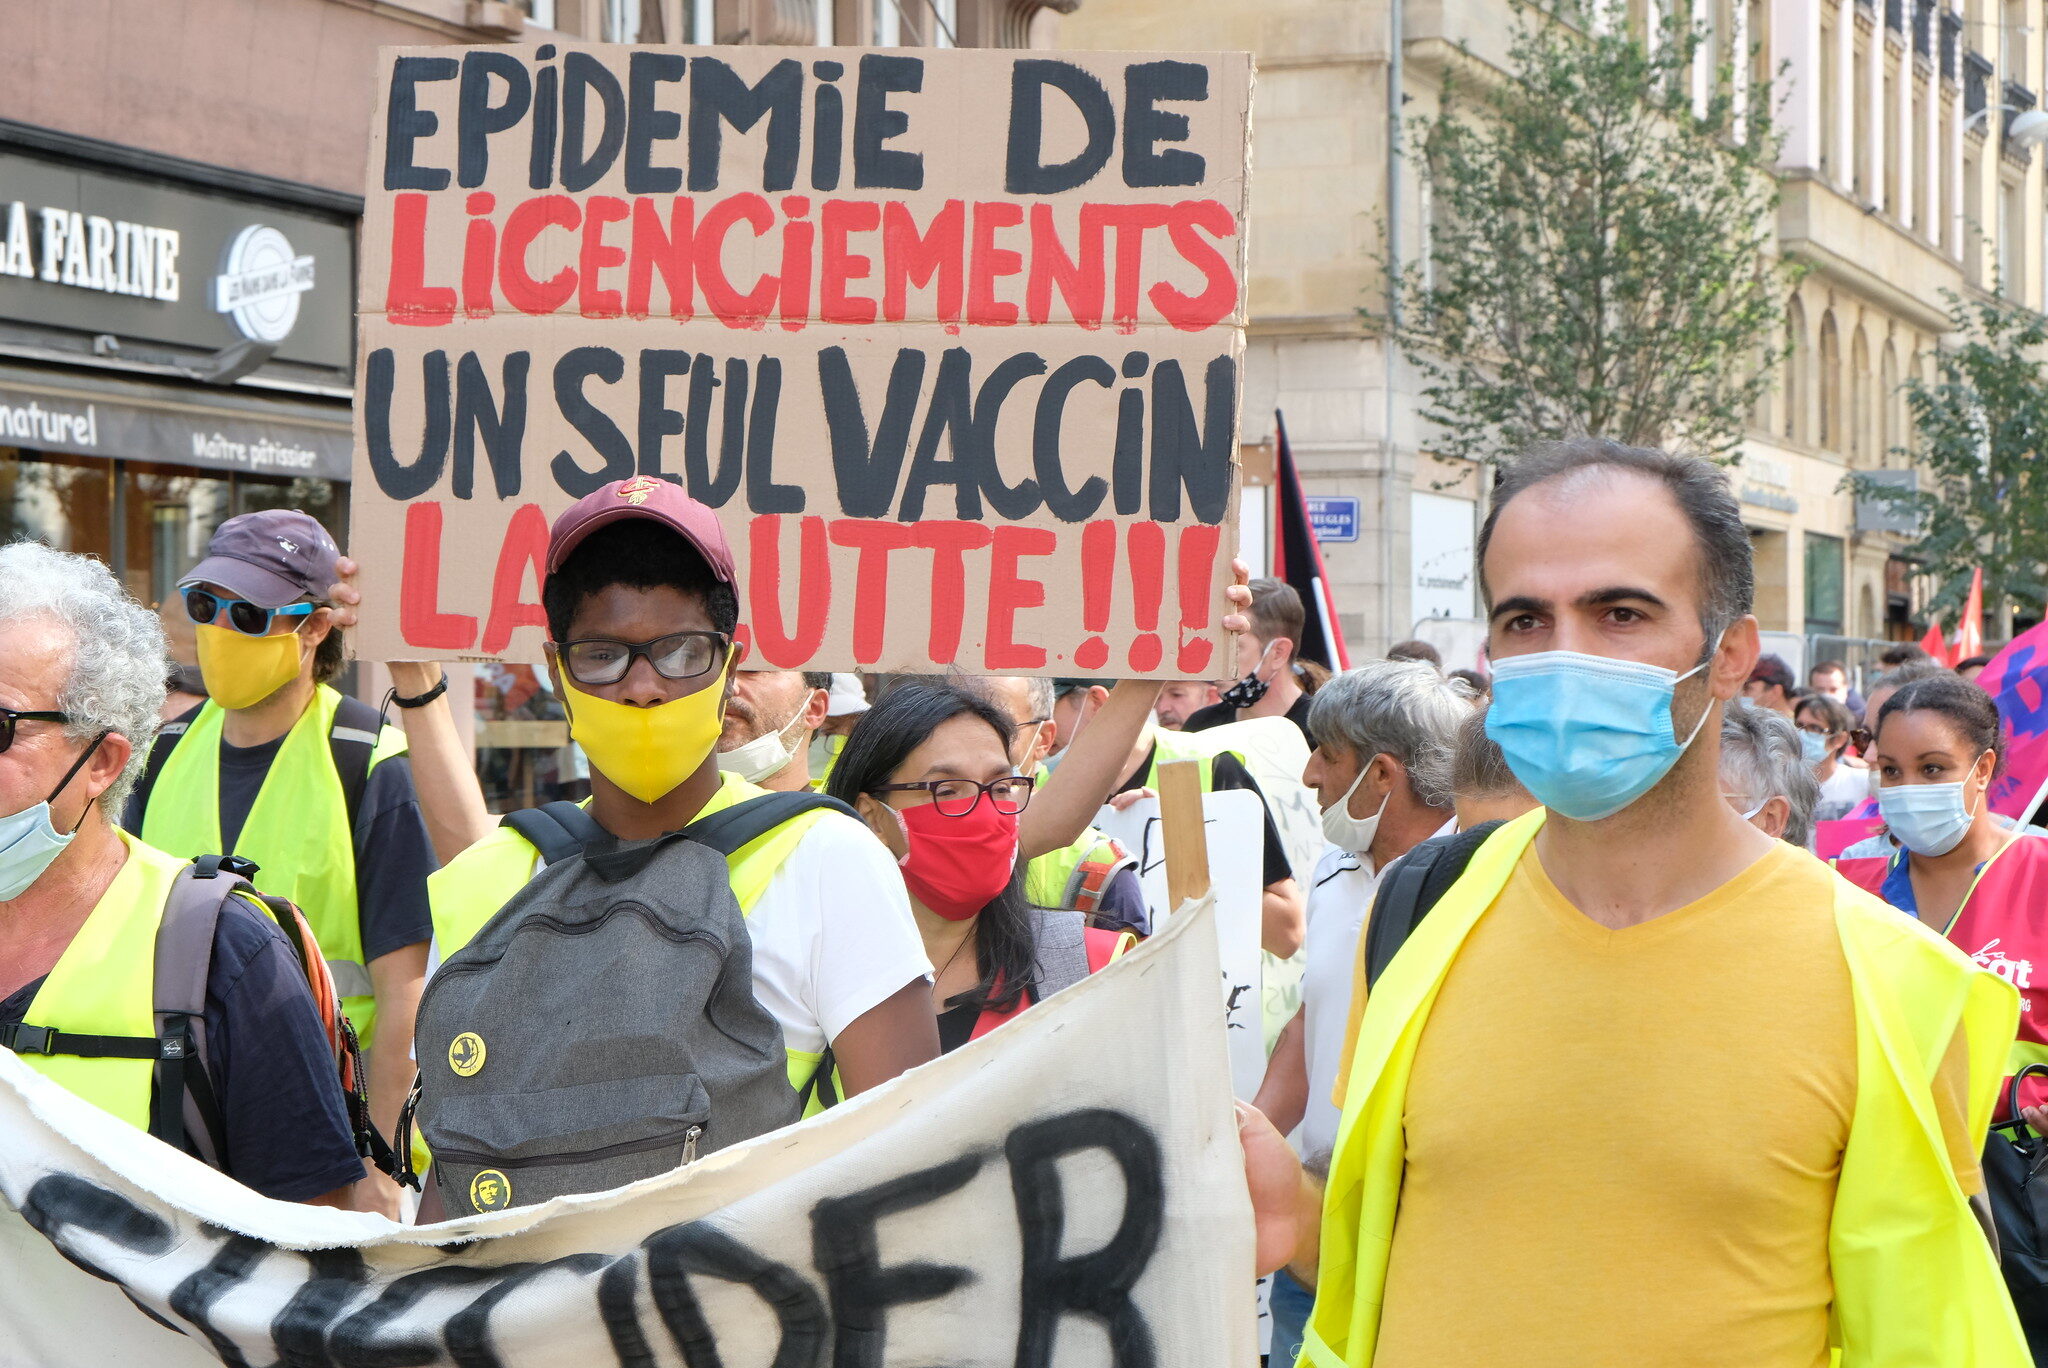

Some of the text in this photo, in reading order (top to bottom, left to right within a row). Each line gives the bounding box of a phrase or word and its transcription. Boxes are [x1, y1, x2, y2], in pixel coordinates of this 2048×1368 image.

[1006, 60, 1208, 194] DE
[40, 206, 180, 302] FARINE
[0, 401, 97, 447] naturel
[193, 432, 317, 470] Maître pâtissier
[365, 348, 530, 500] UN
[551, 347, 805, 515] SEUL
[1308, 513, 1352, 526] EUGLES
